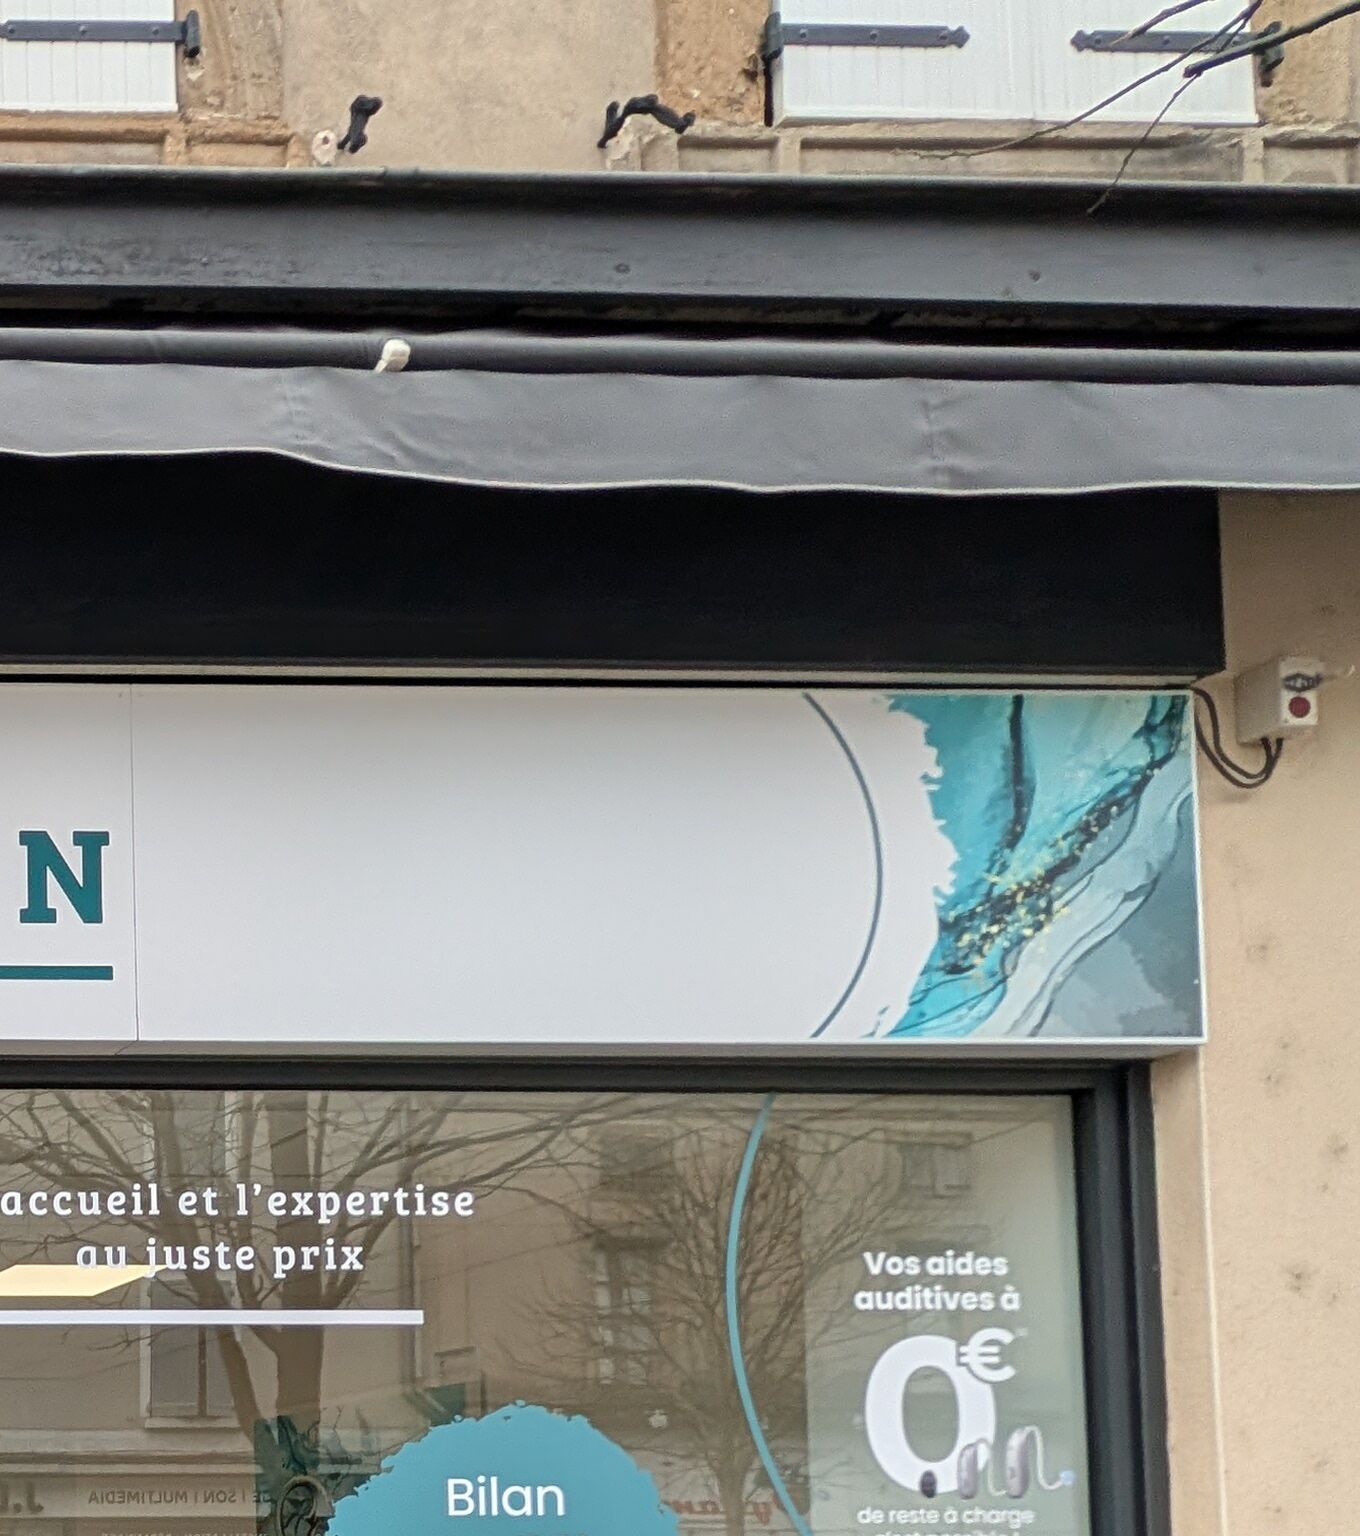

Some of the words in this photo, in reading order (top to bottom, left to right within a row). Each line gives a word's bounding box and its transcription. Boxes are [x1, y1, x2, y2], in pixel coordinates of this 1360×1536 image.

[178, 1186, 219, 1216] et
[236, 1183, 476, 1224] l'expertise
[76, 1243, 128, 1271] au
[145, 1236, 256, 1278] juste
[272, 1236, 365, 1279] prix
[863, 1250, 921, 1276] Vos
[925, 1249, 1009, 1276] aides
[854, 1284, 996, 1311] auditives
[1000, 1284, 1021, 1311] à
[446, 1475, 565, 1517] Bilan
[857, 1506, 884, 1524] de
[888, 1507, 940, 1524] reste
[944, 1505, 959, 1524] à
[962, 1506, 1035, 1529] charge
